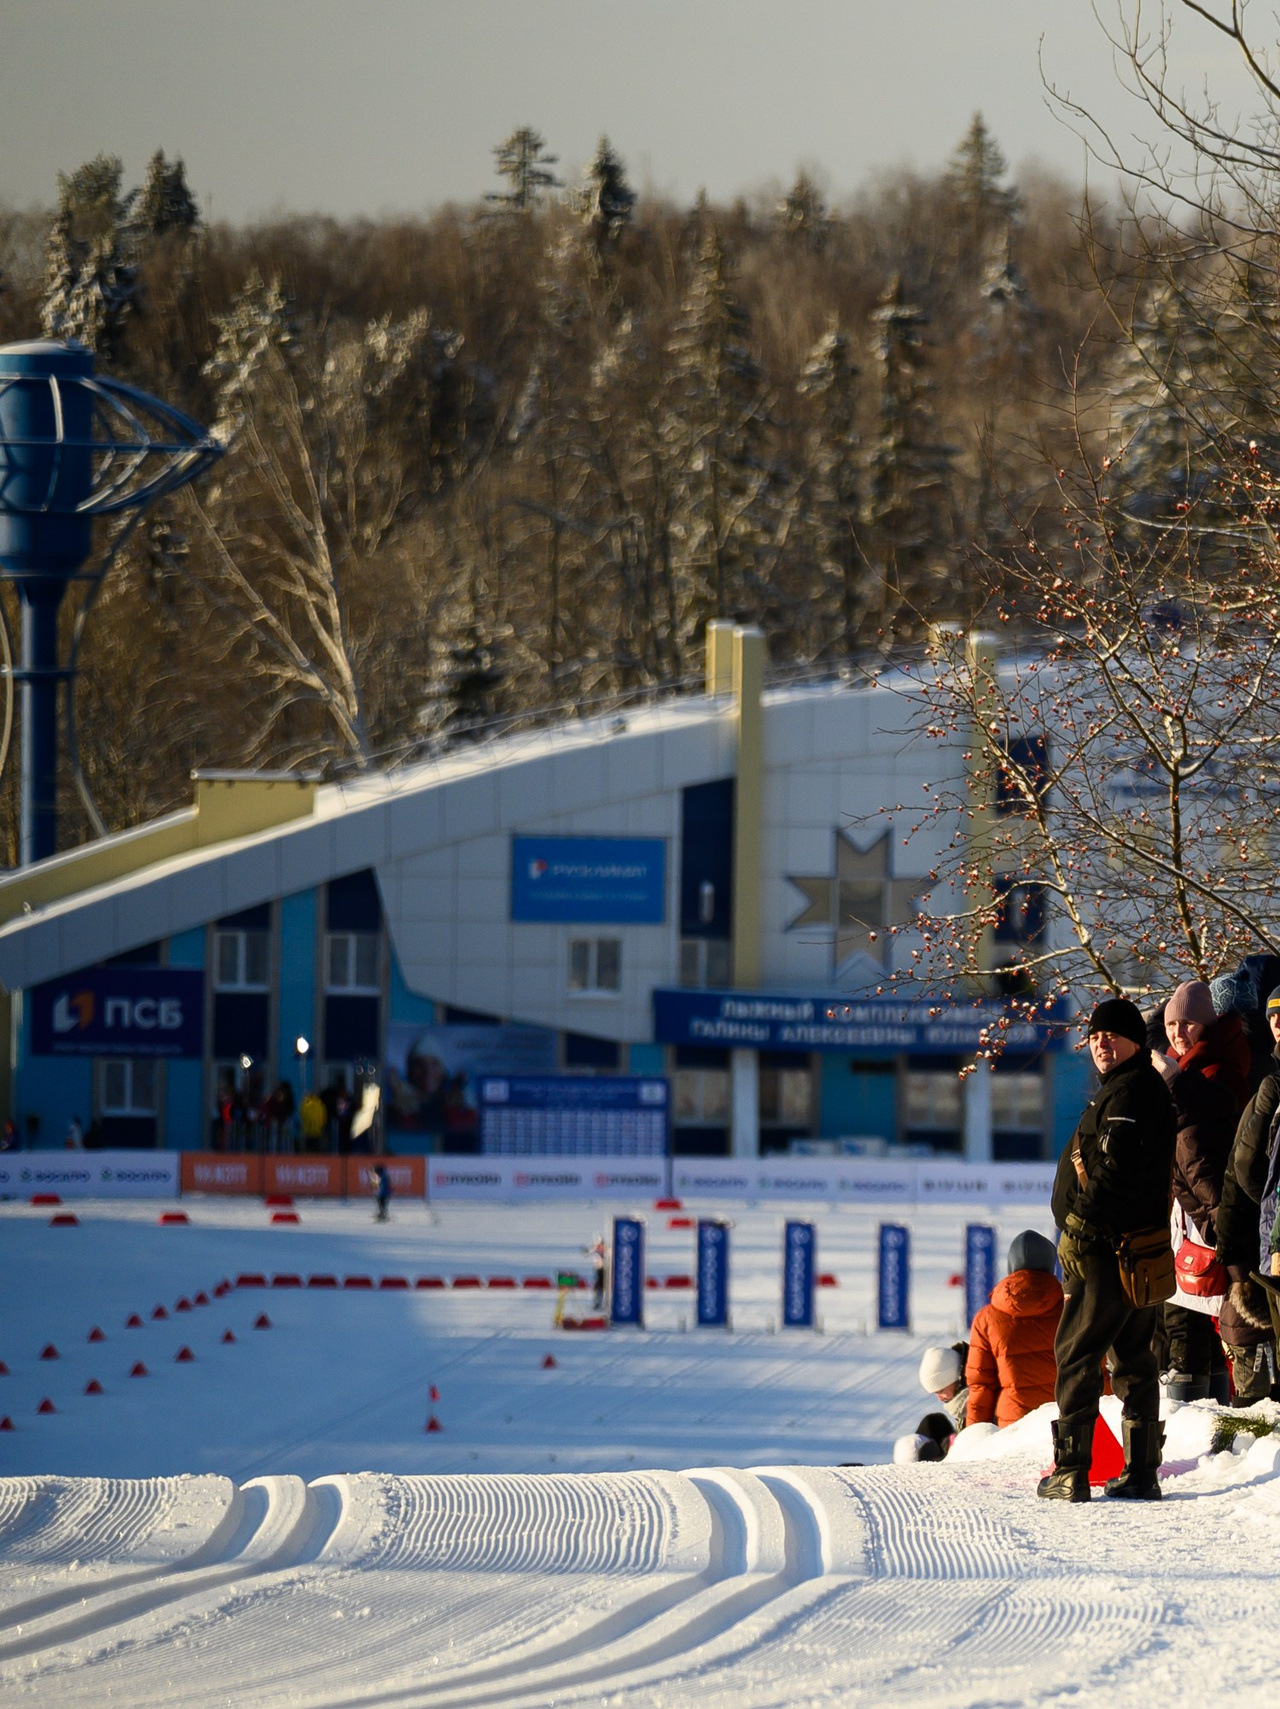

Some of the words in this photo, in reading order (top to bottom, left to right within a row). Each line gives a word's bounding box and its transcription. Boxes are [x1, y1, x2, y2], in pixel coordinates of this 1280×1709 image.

[104, 996, 184, 1030] ПСБ
[722, 998, 814, 1021] ЛЫЖНЫЙ
[690, 1017, 770, 1041] ГАЛИНЫ
